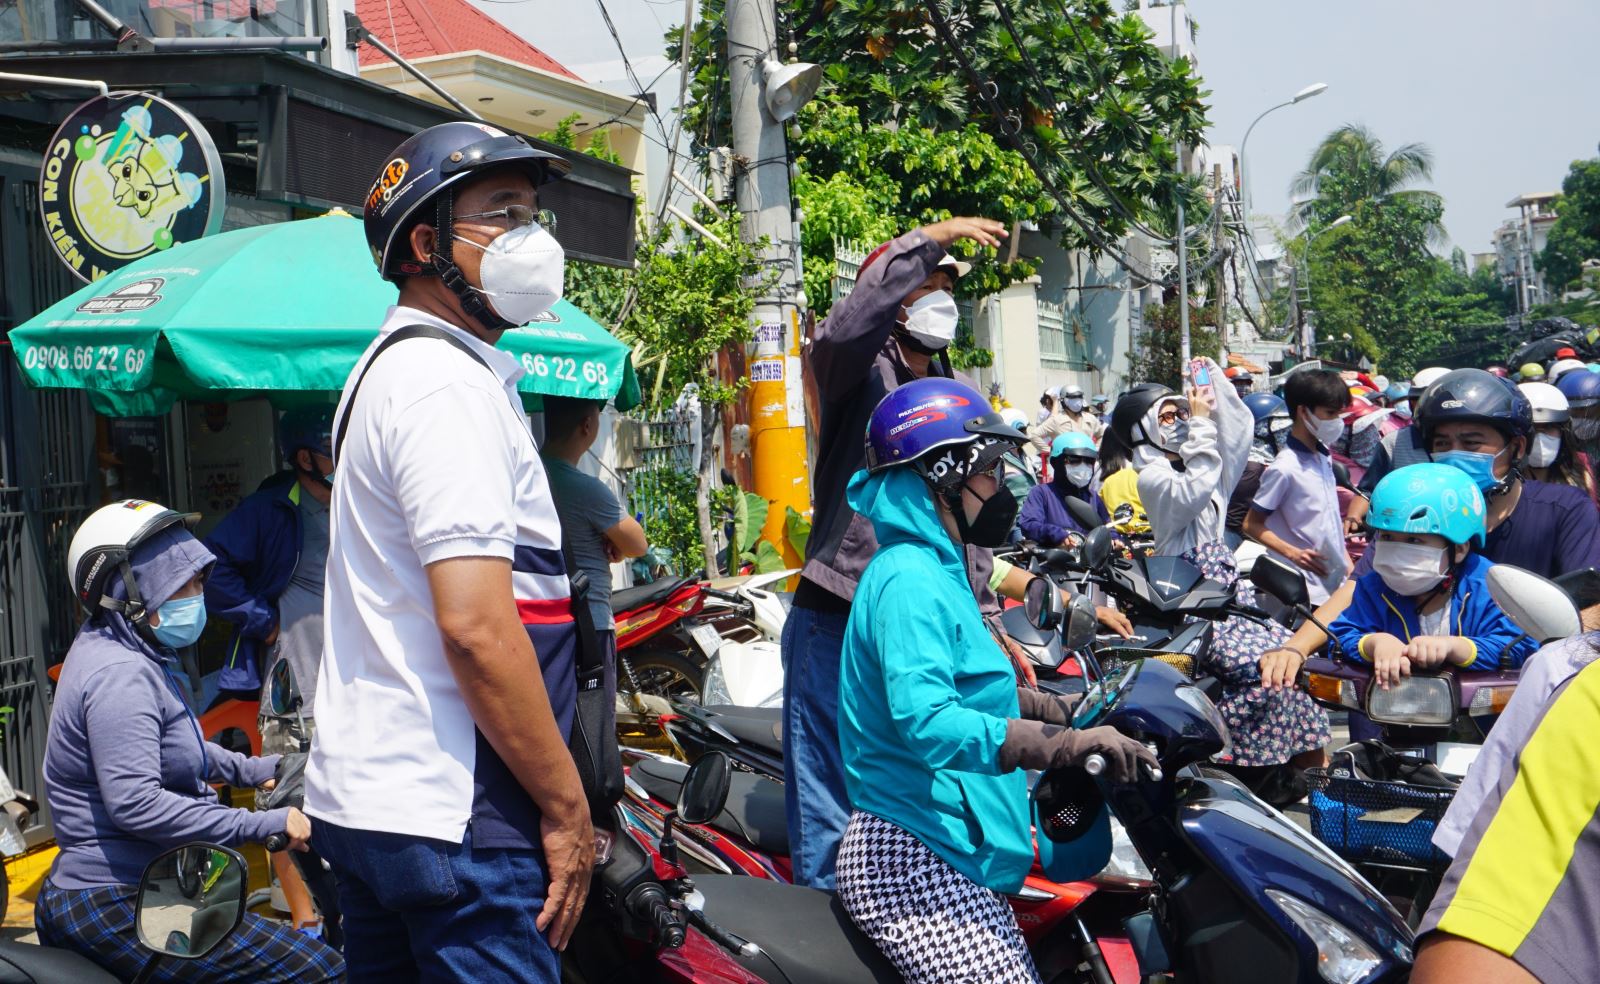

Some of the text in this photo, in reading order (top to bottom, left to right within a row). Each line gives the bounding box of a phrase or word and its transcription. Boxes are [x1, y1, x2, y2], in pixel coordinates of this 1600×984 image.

[44, 138, 71, 202] CON
[25, 346, 146, 374] 0908.66 22 68
[552, 356, 577, 382] 22
[582, 361, 609, 385] 68
